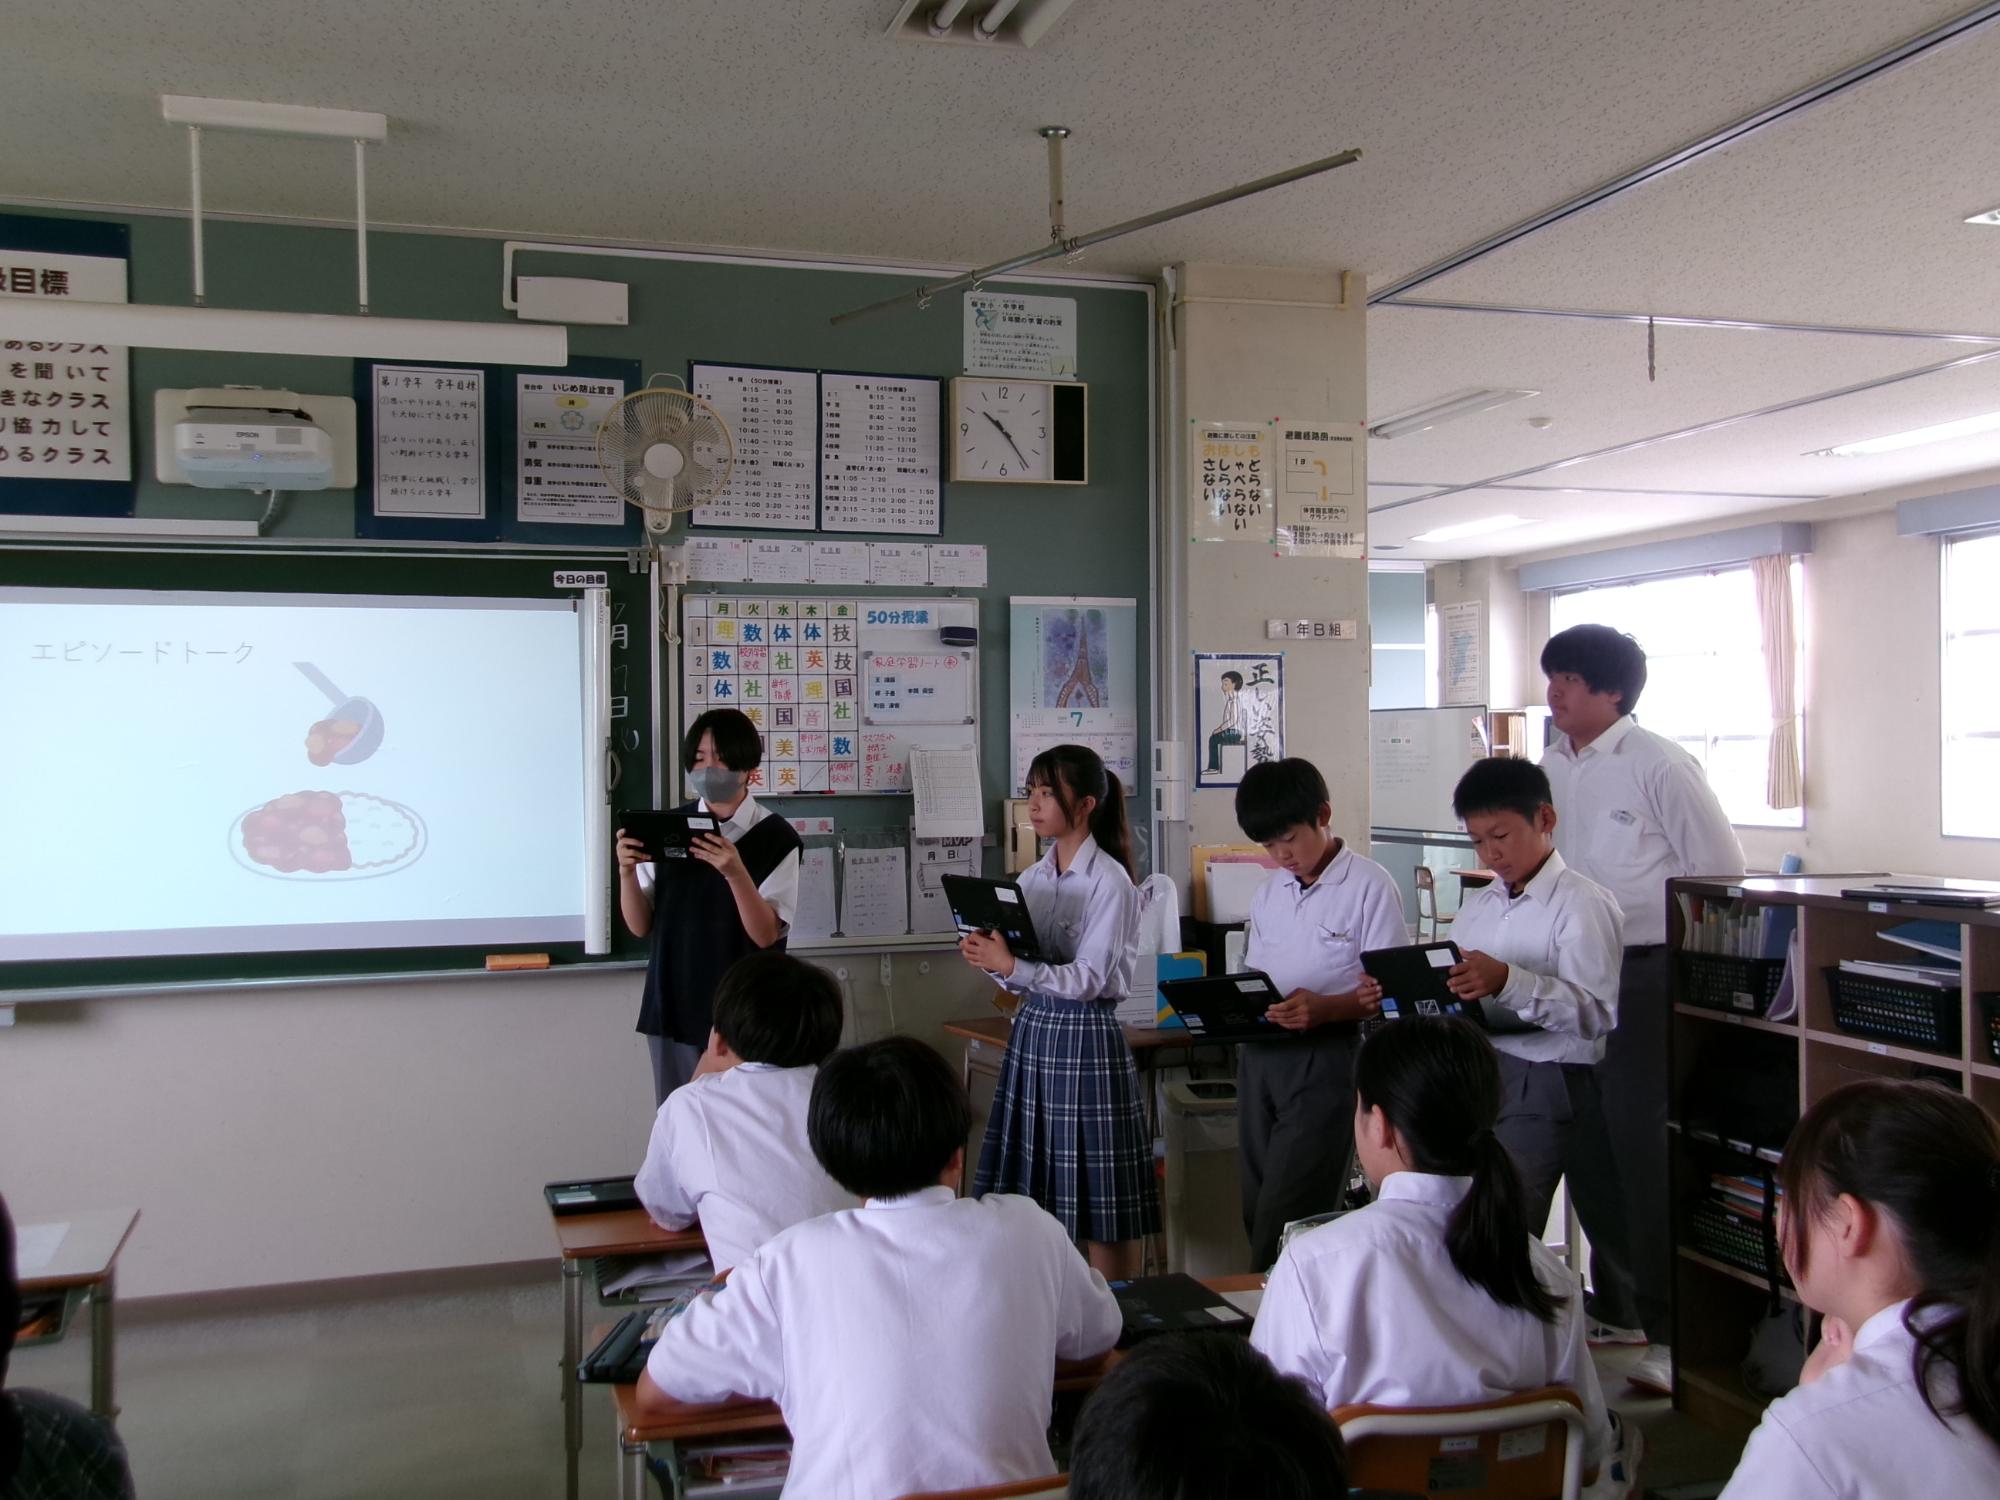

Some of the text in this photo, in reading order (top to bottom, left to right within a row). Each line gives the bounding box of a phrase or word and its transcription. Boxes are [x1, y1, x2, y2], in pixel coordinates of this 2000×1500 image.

[0, 267, 69, 295] 目標
[998, 386, 1009, 399] 12
[236, 432, 260, 441] EPSON
[960, 422, 969, 437] 9
[1038, 427, 1046, 439] 3
[999, 463, 1008, 477] 6
[554, 574, 606, 585] 今日の目標
[717, 603, 848, 616] 月 火 水 木 金
[867, 610, 929, 624] 50分授業
[696, 626, 701, 637] 1
[743, 623, 762, 641] 数
[773, 623, 792, 642] 体
[804, 623, 822, 641] 体
[832, 623, 851, 641] 技
[1283, 622, 1342, 637] 1年B組
[30, 639, 255, 664] エピソードトーク
[696, 656, 702, 666] 2
[712, 651, 732, 670] 数
[776, 651, 794, 670] 社
[806, 650, 823, 668] 英
[834, 652, 852, 670] 技
[696, 684, 702, 694] 3
[714, 679, 732, 698] 体
[744, 679, 763, 698] 社
[805, 681, 823, 699] 理
[835, 679, 853, 696] 国
[776, 707, 793, 725] 国
[805, 710, 821, 726] 音
[833, 701, 851, 720] 社
[1070, 712, 1083, 727] 7
[776, 738, 794, 756] 美
[833, 737, 851, 755] 数
[778, 768, 796, 786] 英
